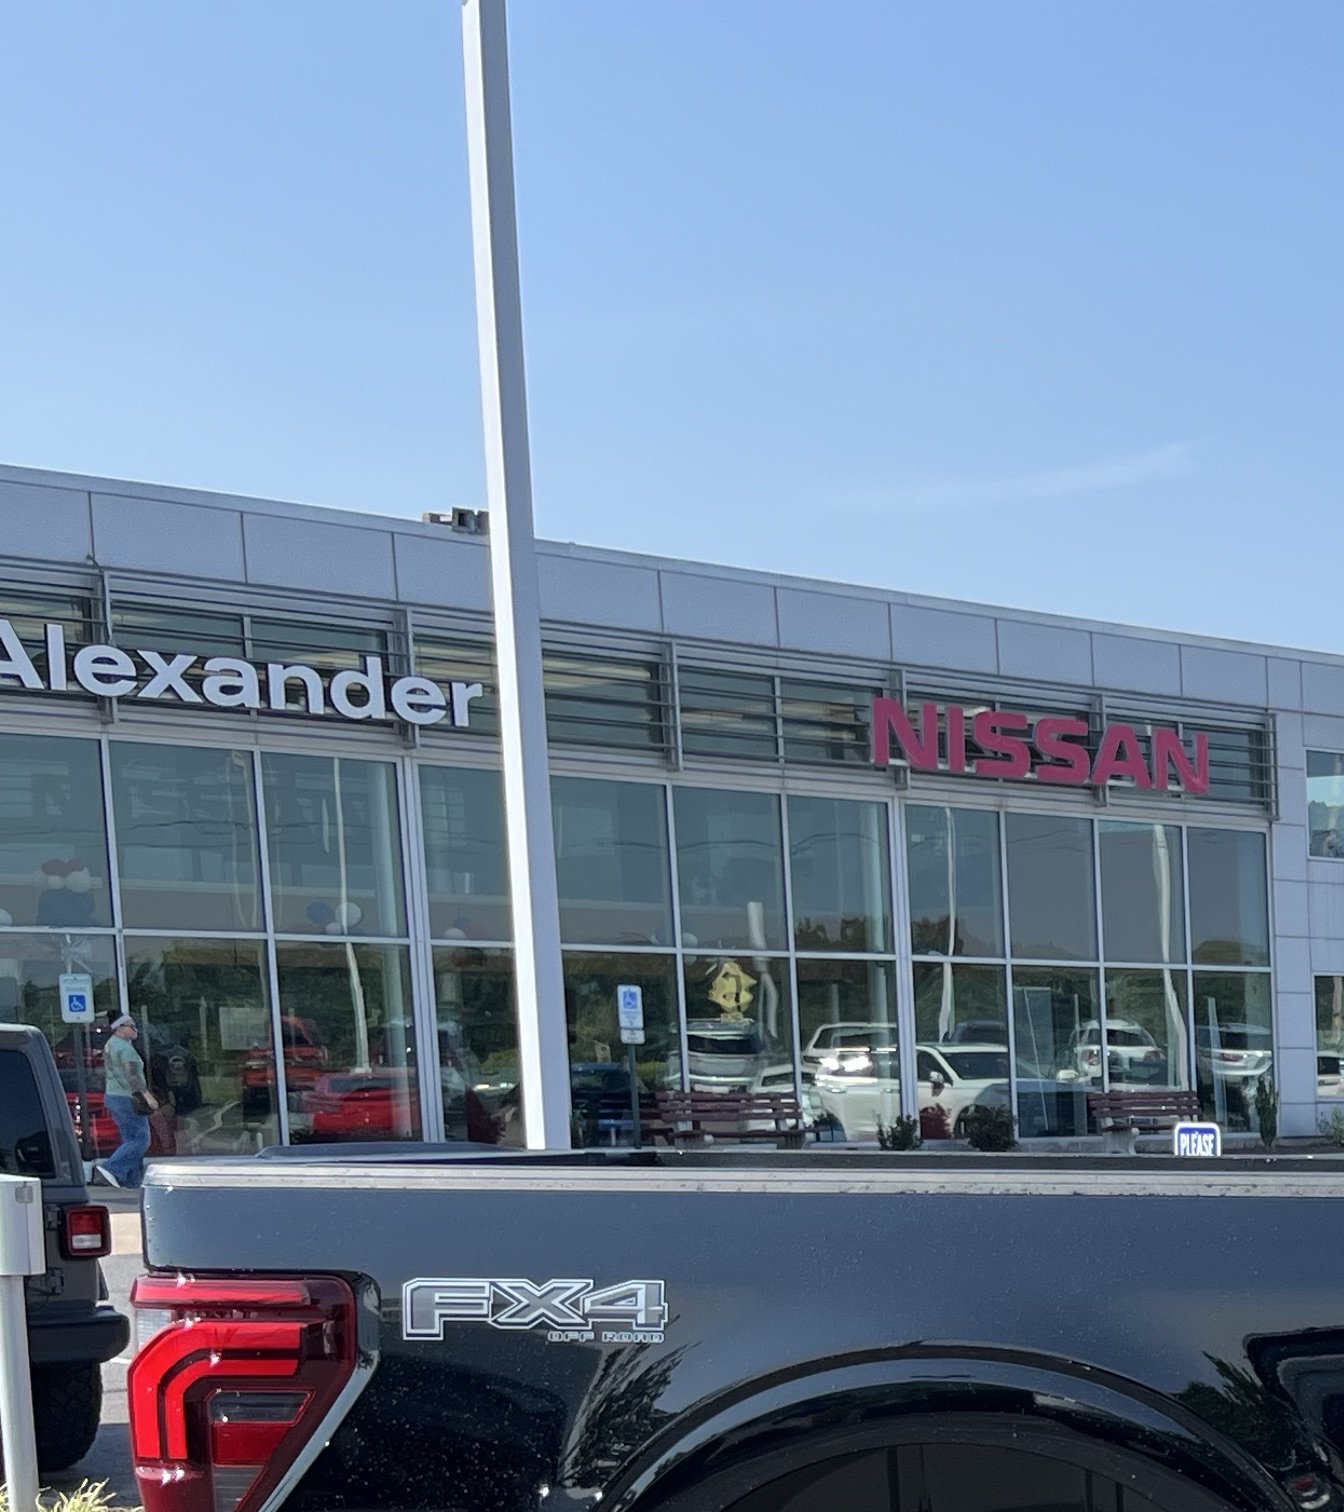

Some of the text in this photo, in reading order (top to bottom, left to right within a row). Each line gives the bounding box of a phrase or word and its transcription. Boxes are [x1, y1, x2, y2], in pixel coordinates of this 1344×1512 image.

[0, 619, 484, 728] Alexander
[870, 696, 1210, 796] NISSAN
[1180, 1133, 1215, 1156] PLEASE
[402, 1277, 670, 1342] FX4
[548, 1331, 665, 1344] OFF ROAD
